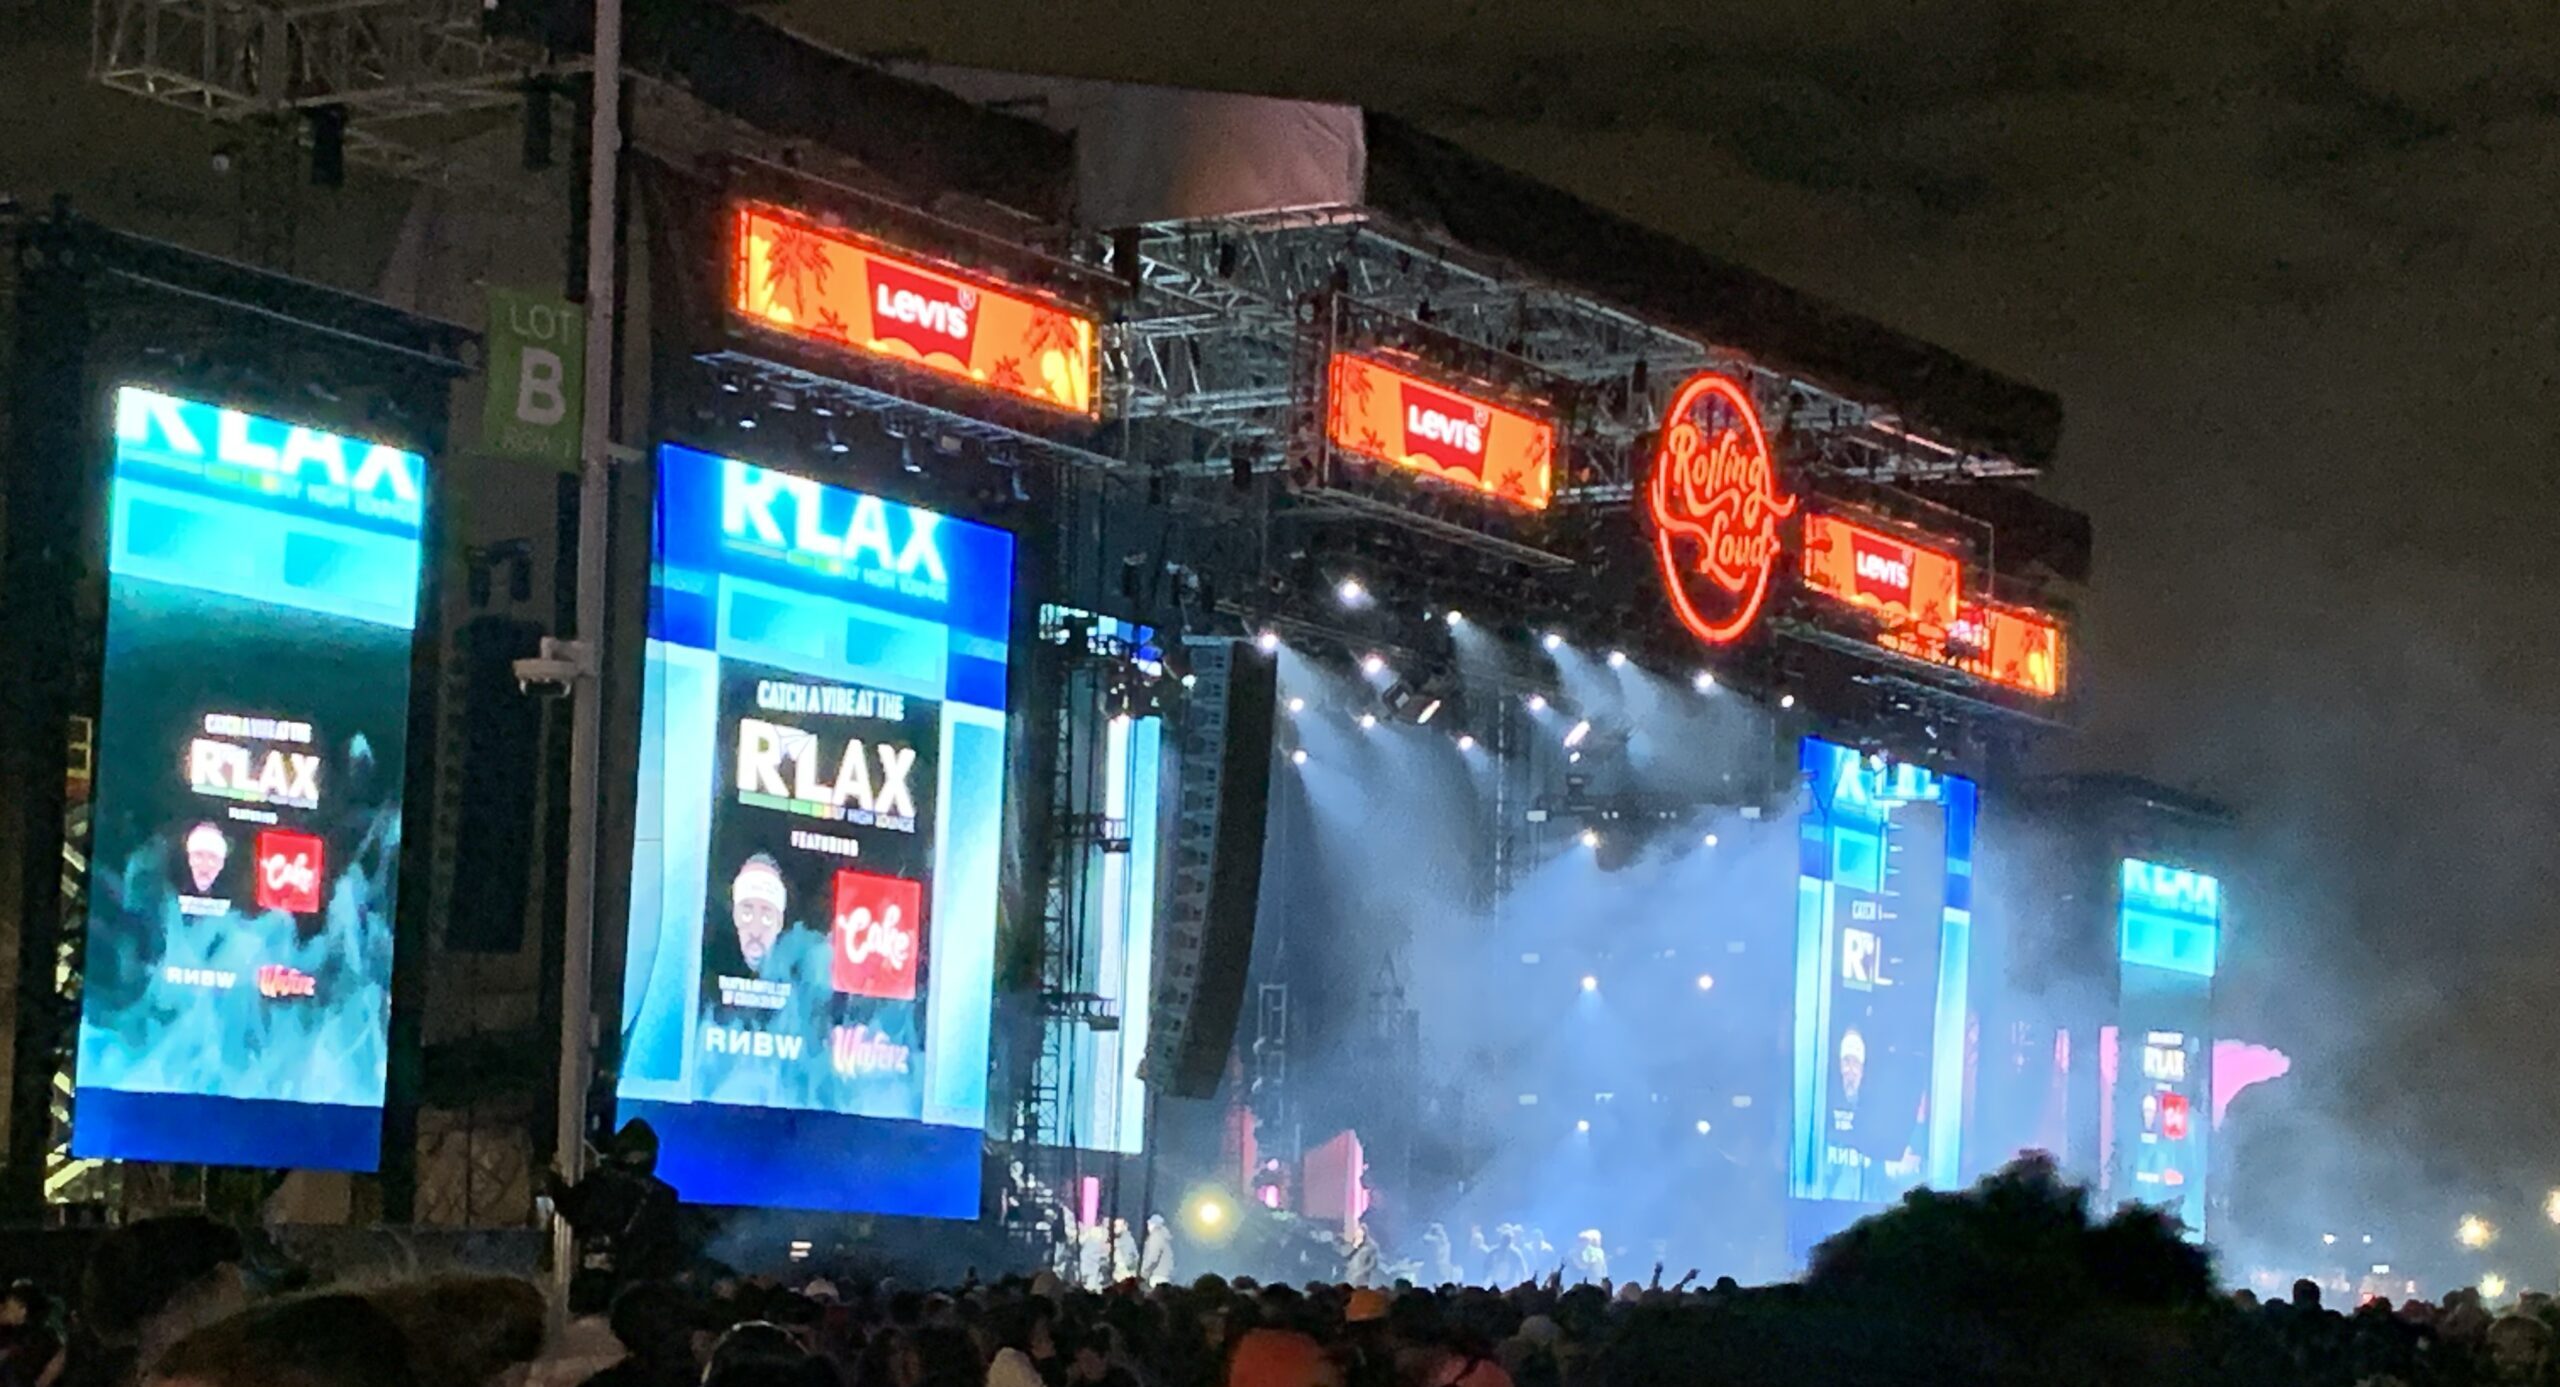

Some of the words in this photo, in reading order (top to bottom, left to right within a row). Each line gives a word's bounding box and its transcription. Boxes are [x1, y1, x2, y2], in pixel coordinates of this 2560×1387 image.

[509, 303, 572, 346] LOT
[516, 346, 566, 426] B
[1669, 423, 1796, 530] Rolling
[1700, 510, 1780, 592] Loud
[756, 679, 807, 713] CATCH
[807, 685, 821, 713] A
[821, 686, 855, 716] VIBE
[855, 689, 874, 718] AT
[877, 691, 905, 721] THE
